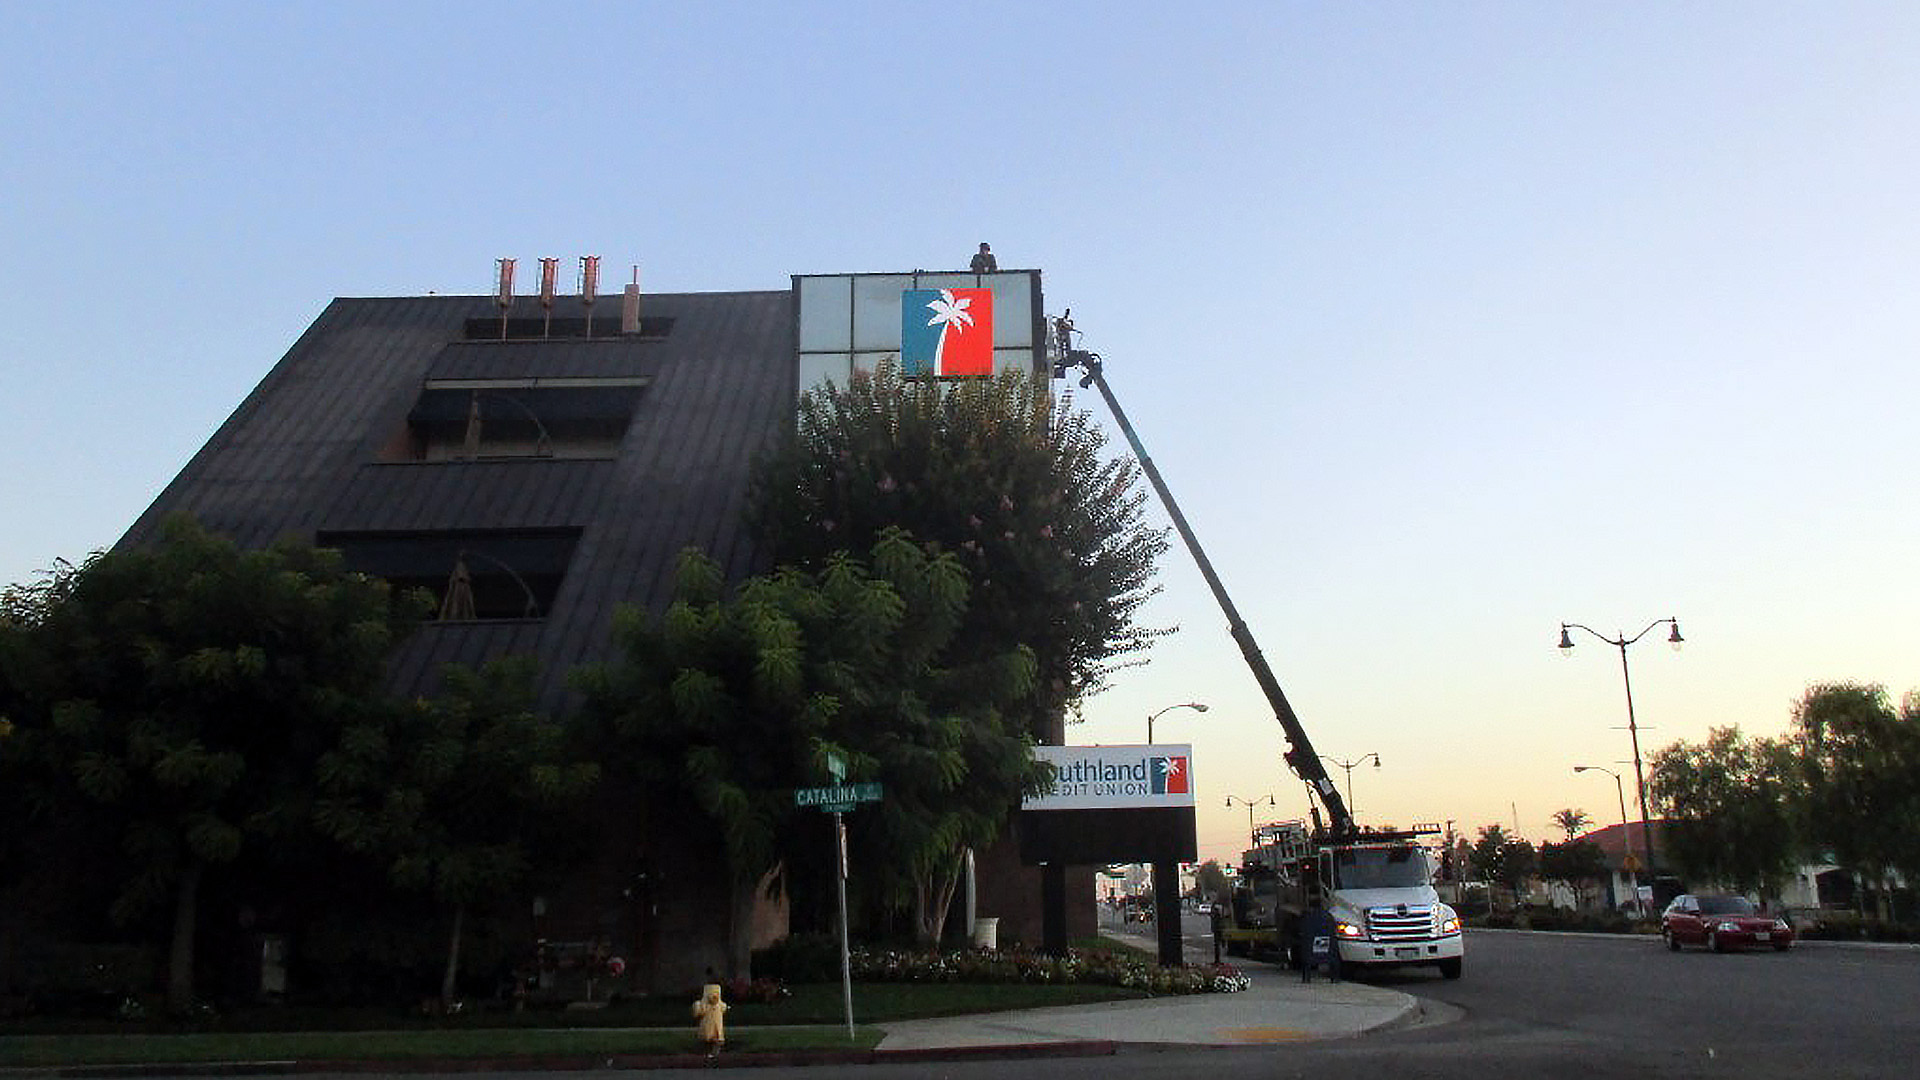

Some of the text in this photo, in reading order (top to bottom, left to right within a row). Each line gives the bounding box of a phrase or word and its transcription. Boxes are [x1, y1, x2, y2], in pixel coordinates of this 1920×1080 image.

[1051, 757, 1146, 782] uthland
[797, 787, 857, 805] CATALINA
[1050, 783, 1148, 796] EDIT UNION
